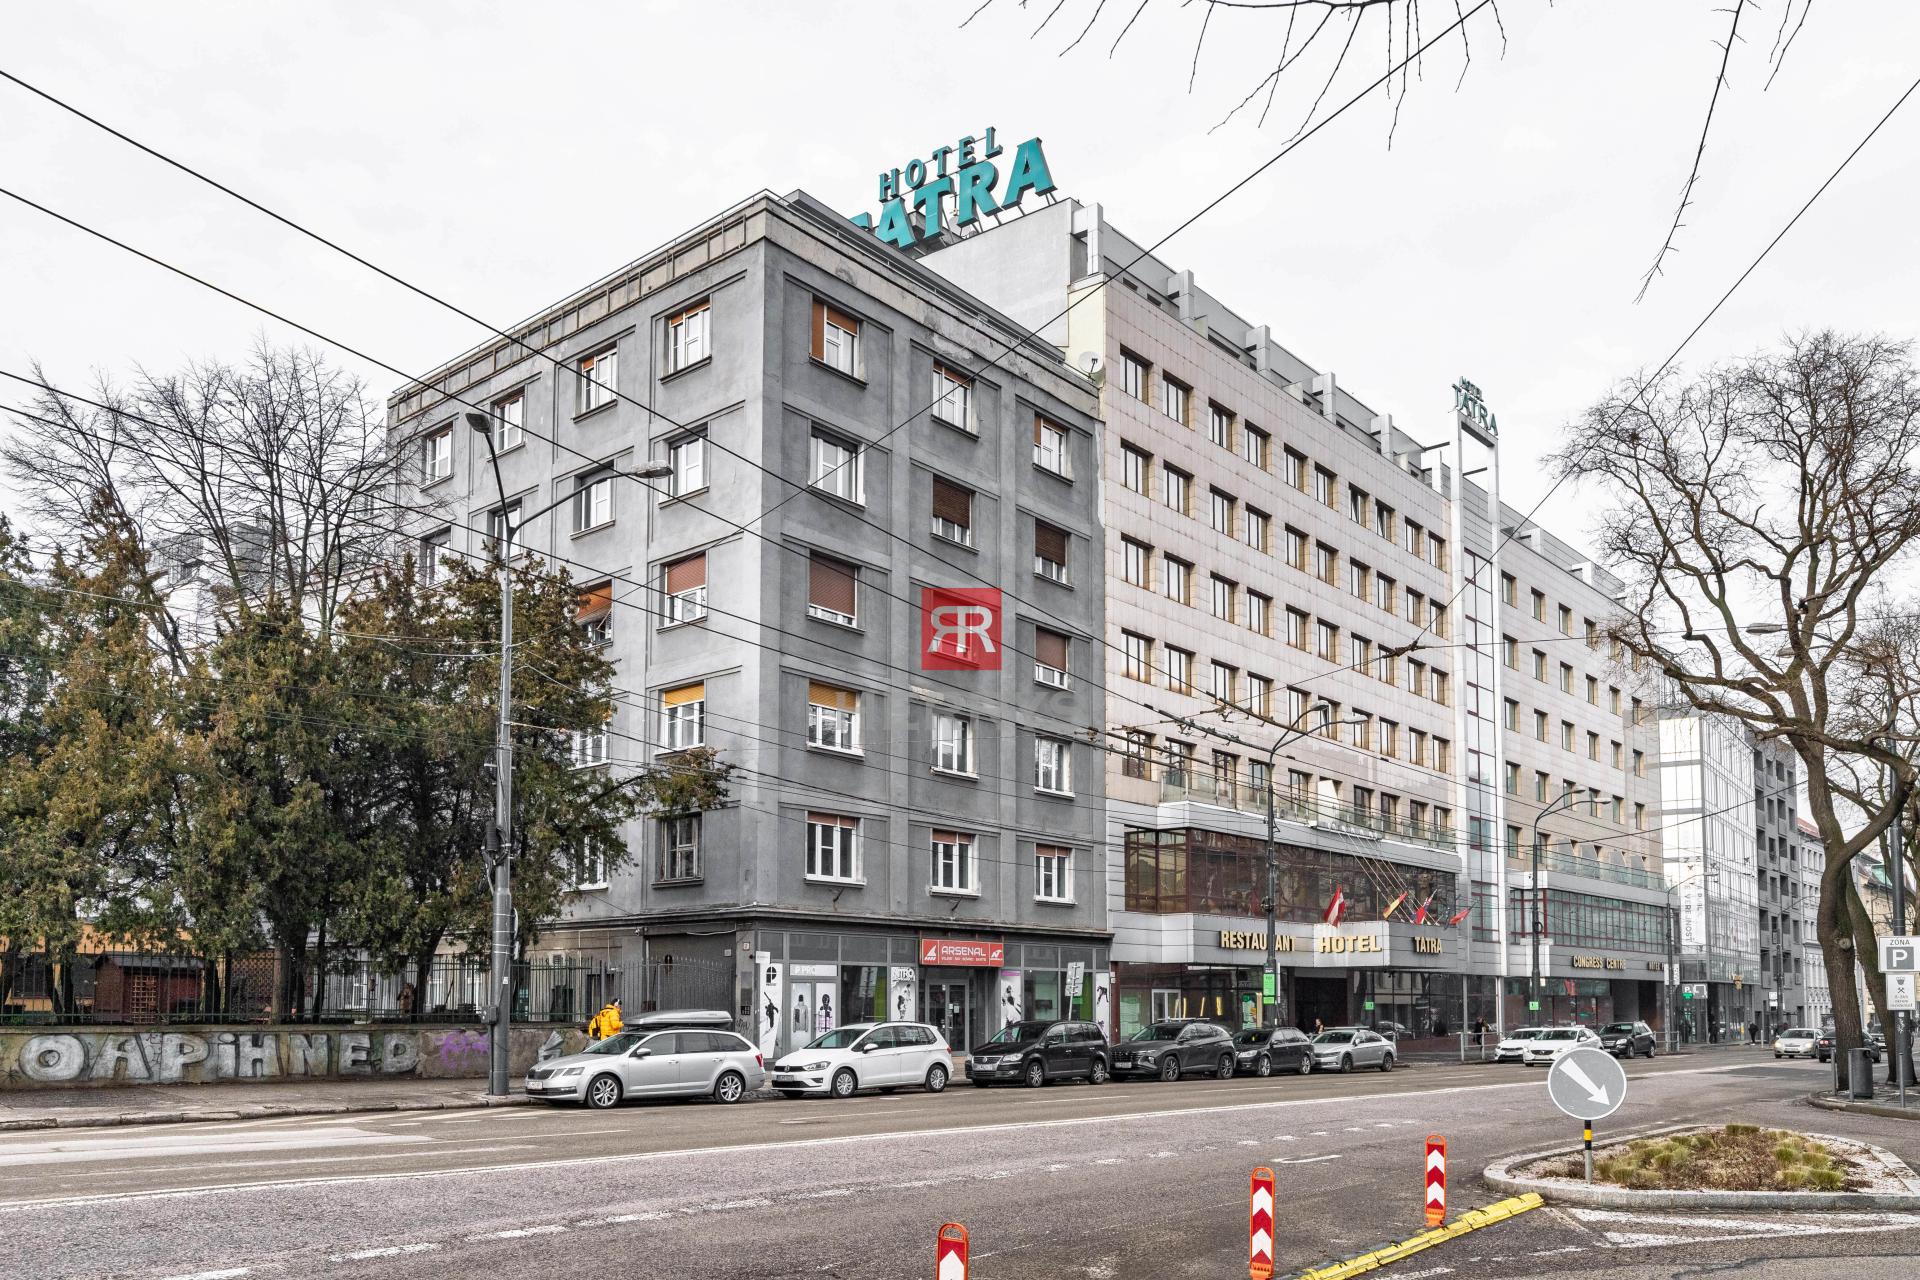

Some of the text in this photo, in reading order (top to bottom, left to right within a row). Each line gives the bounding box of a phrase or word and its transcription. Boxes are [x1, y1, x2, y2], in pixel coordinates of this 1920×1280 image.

[879, 126, 1003, 202] HOTEL
[1452, 384, 1498, 436] TATRA
[1220, 931, 1296, 952] RESTAUANT
[1320, 936, 1382, 953] HOTEL
[1415, 936, 1443, 954] TATRA
[1890, 937, 1910, 945] ZÓNA
[941, 945, 987, 957] ARSENAL
[1892, 949, 1908, 968] P
[1573, 955, 1627, 970] CONGRESS CENTRE
